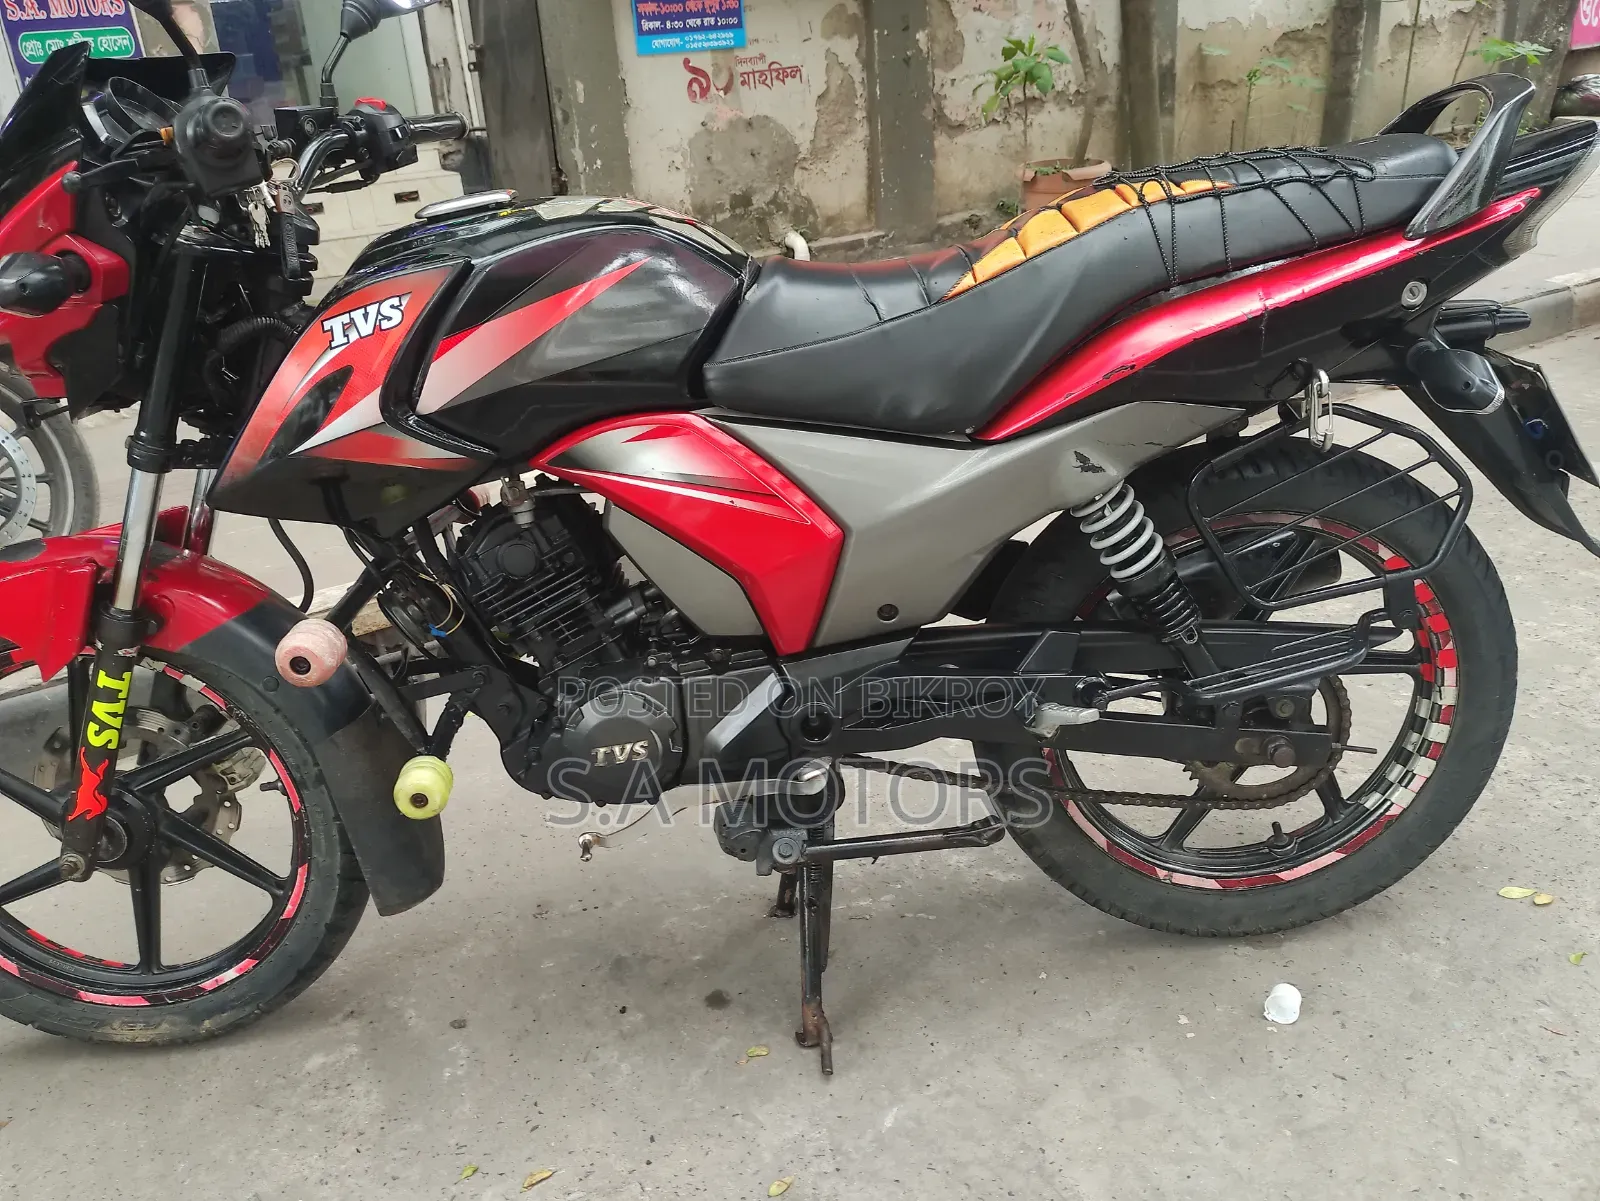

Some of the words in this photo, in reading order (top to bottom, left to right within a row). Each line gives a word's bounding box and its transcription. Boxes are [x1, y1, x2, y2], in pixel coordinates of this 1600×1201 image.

[97, 34, 131, 52] হোসেন
[740, 61, 803, 91] মাহফিল
[321, 294, 405, 350] TVS
[87, 669, 132, 749] TVS
[591, 740, 649, 767] TVS
